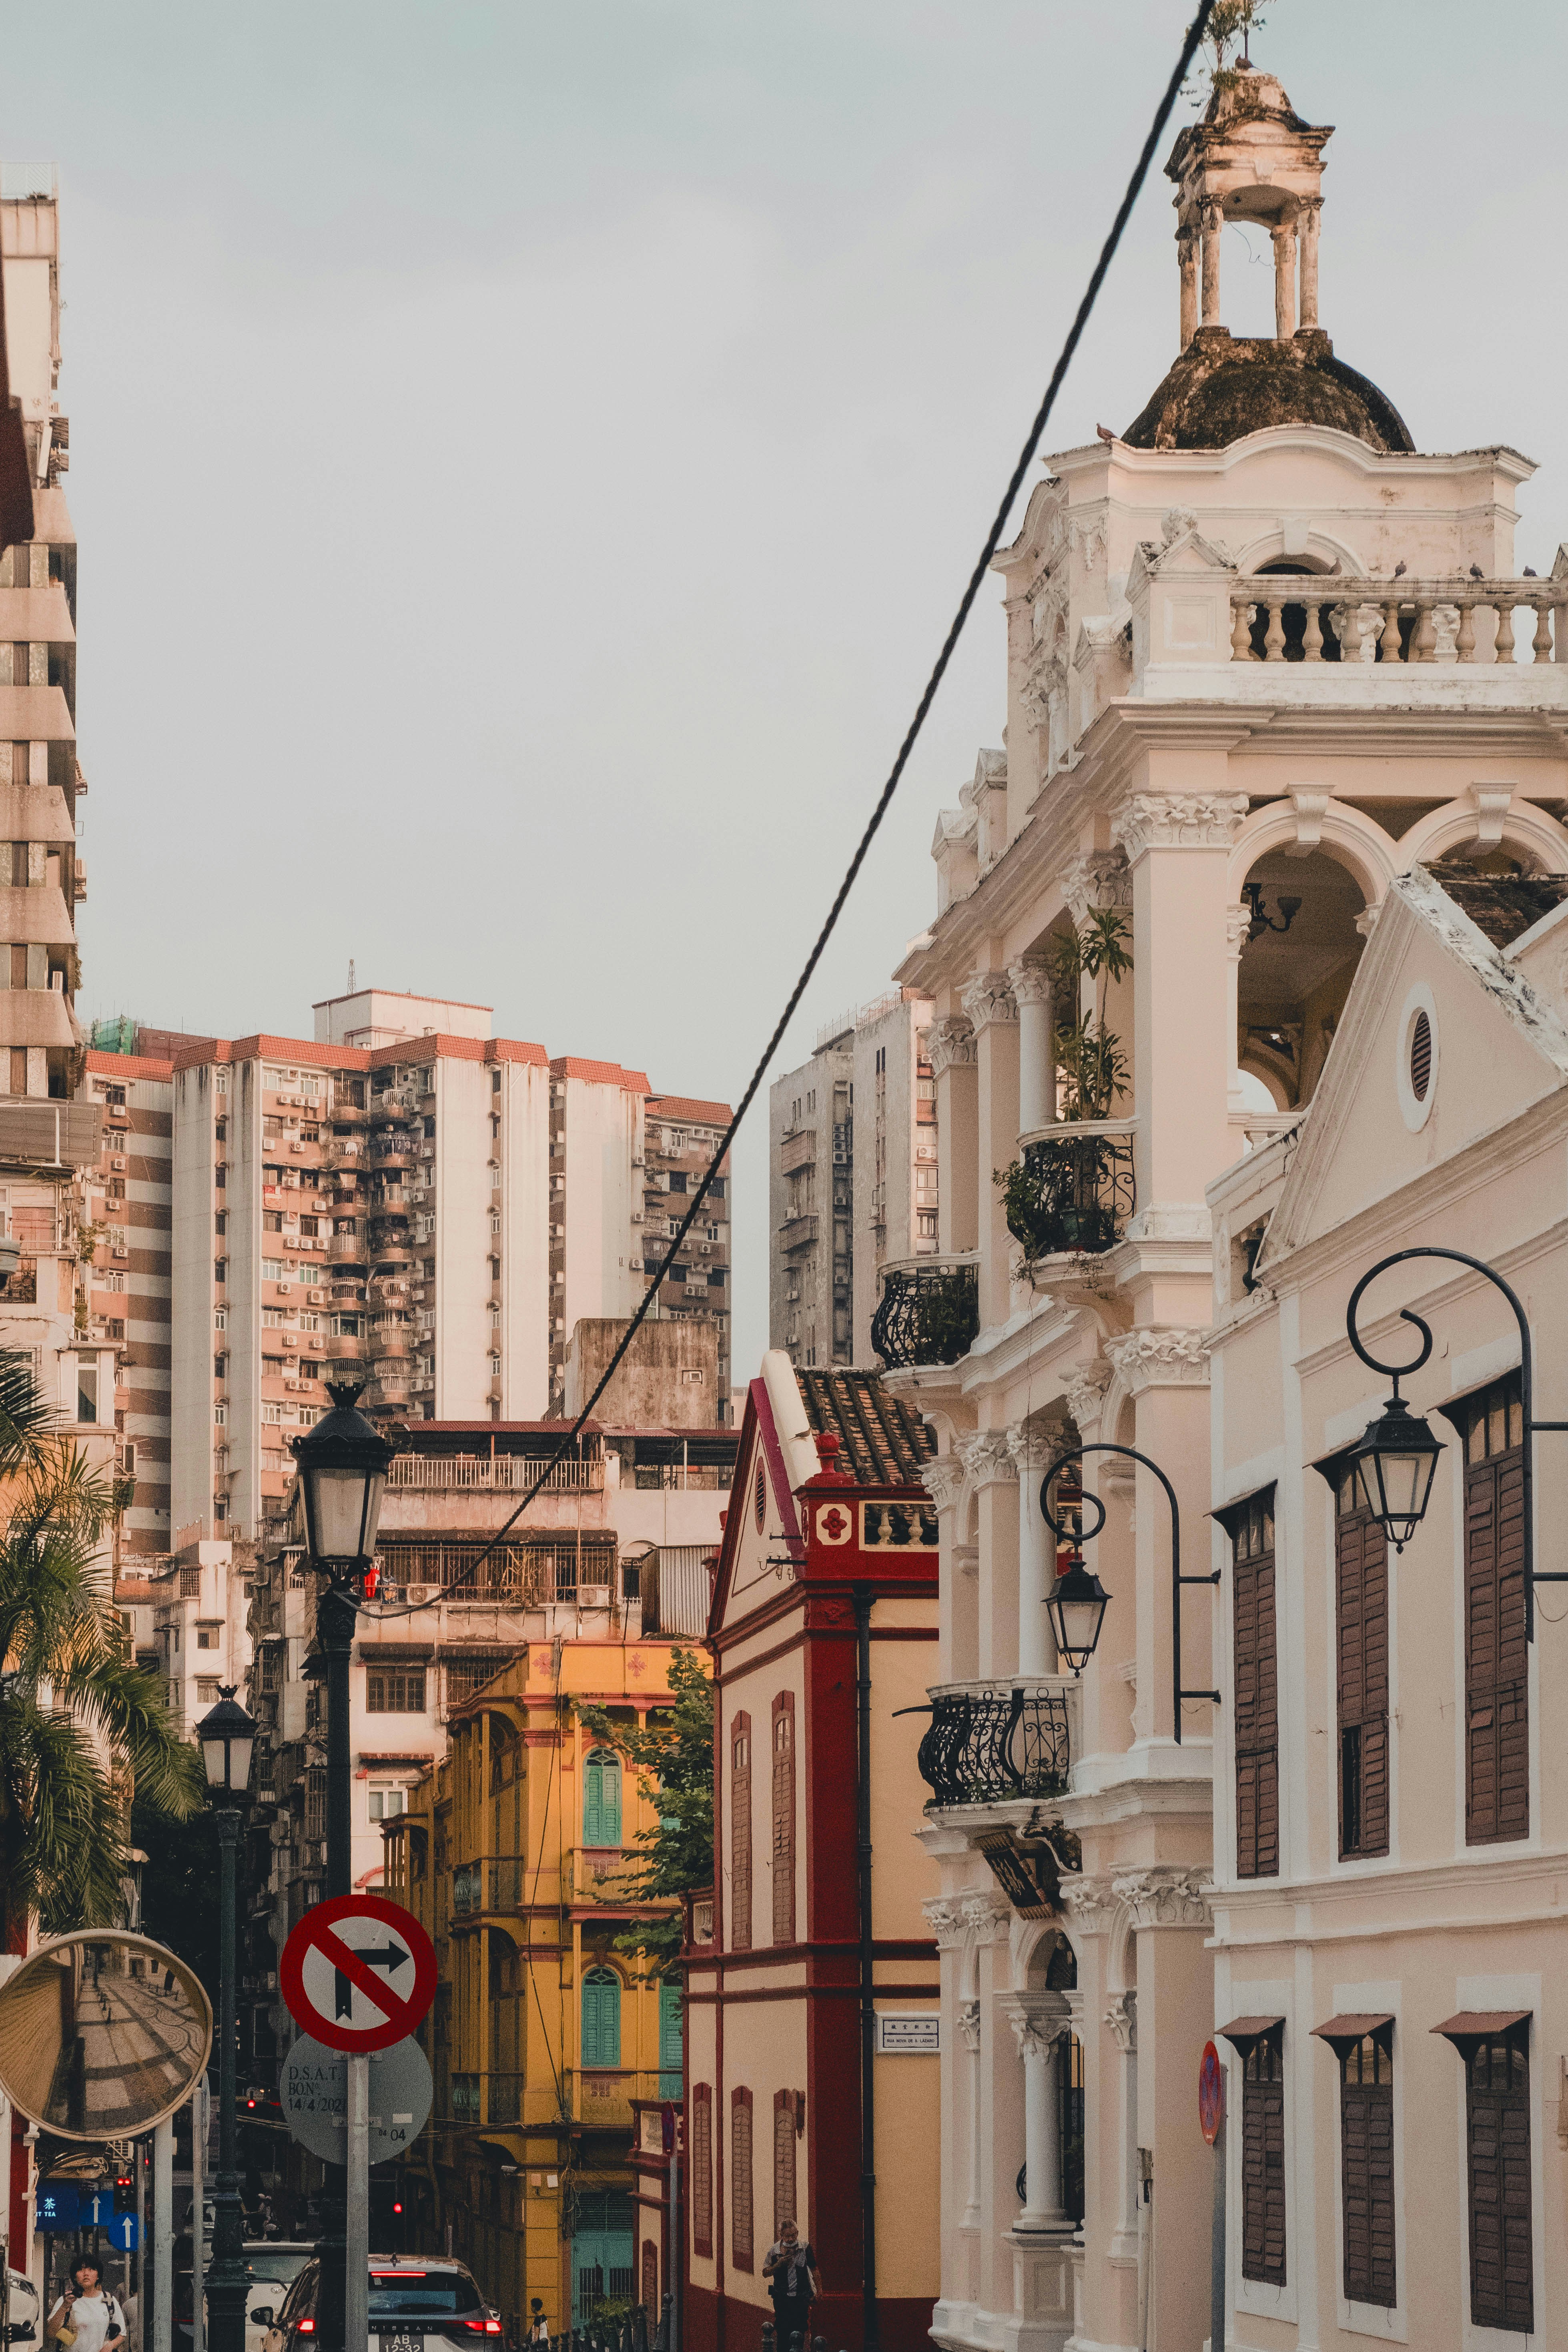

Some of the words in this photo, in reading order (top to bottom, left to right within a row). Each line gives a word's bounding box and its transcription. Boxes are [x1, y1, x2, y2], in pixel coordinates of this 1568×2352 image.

[289, 2066, 341, 2080] D.S.A.T.
[390, 2129, 406, 2141] 04
[43, 2198, 56, 2210] 茶
[393, 2334, 410, 2344] AB
